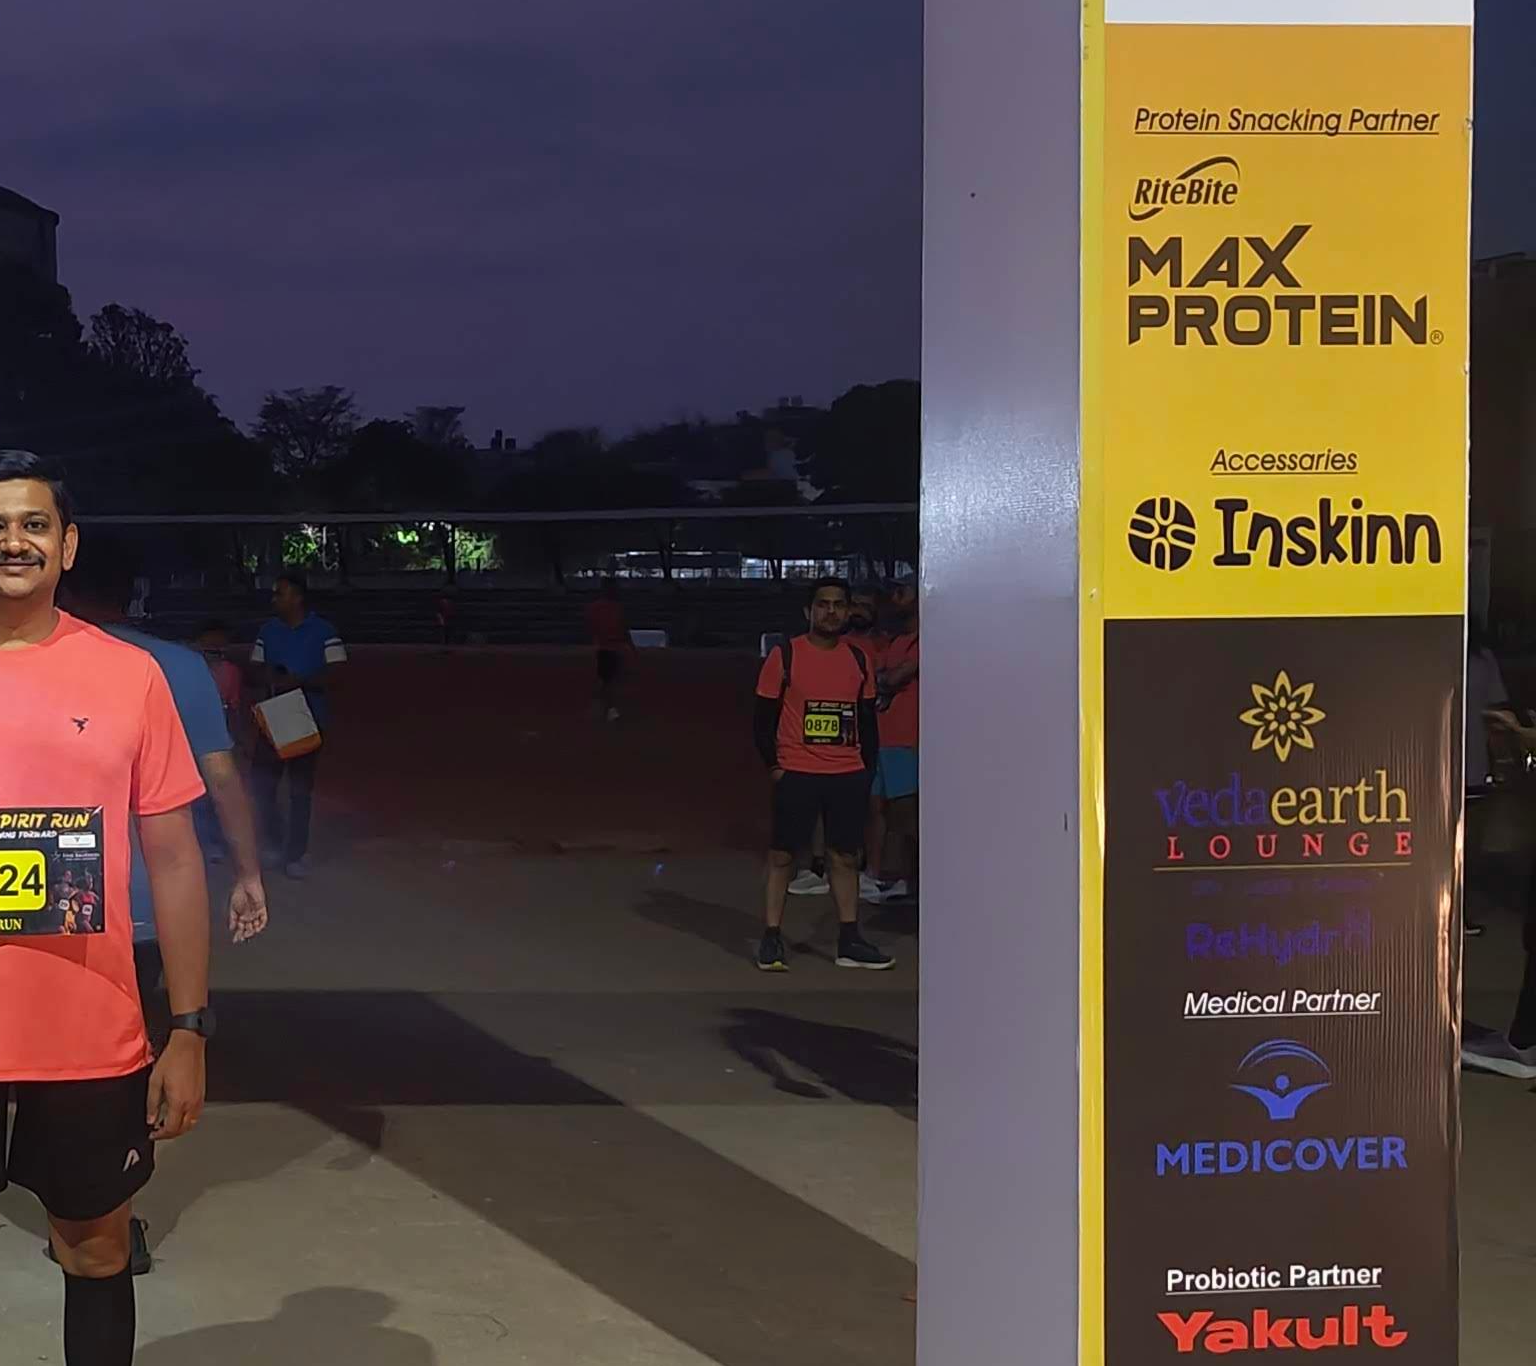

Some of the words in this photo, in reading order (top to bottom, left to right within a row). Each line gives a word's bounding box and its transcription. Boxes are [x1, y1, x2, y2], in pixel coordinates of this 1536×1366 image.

[1134, 108, 1220, 131] Protein
[1228, 108, 1341, 136] Snacking
[1348, 108, 1440, 131] Partner
[1134, 178, 1238, 205] RiteBite
[1128, 224, 1312, 288] MAX
[1209, 448, 1357, 472] Accessaries
[1213, 497, 1442, 568] Inskinn
[805, 719, 839, 732] 0878
[51, 812, 89, 828] RUN
[1167, 831, 1412, 861] LOUNGE
[1183, 991, 1285, 1015] Medical
[1291, 989, 1381, 1012] Partner
[1155, 1135, 1408, 1176] MEDICOVER
[1166, 1267, 1281, 1292] Probiotic
[1289, 1264, 1382, 1288] Partner
[1157, 1305, 1408, 1354] Yakult
